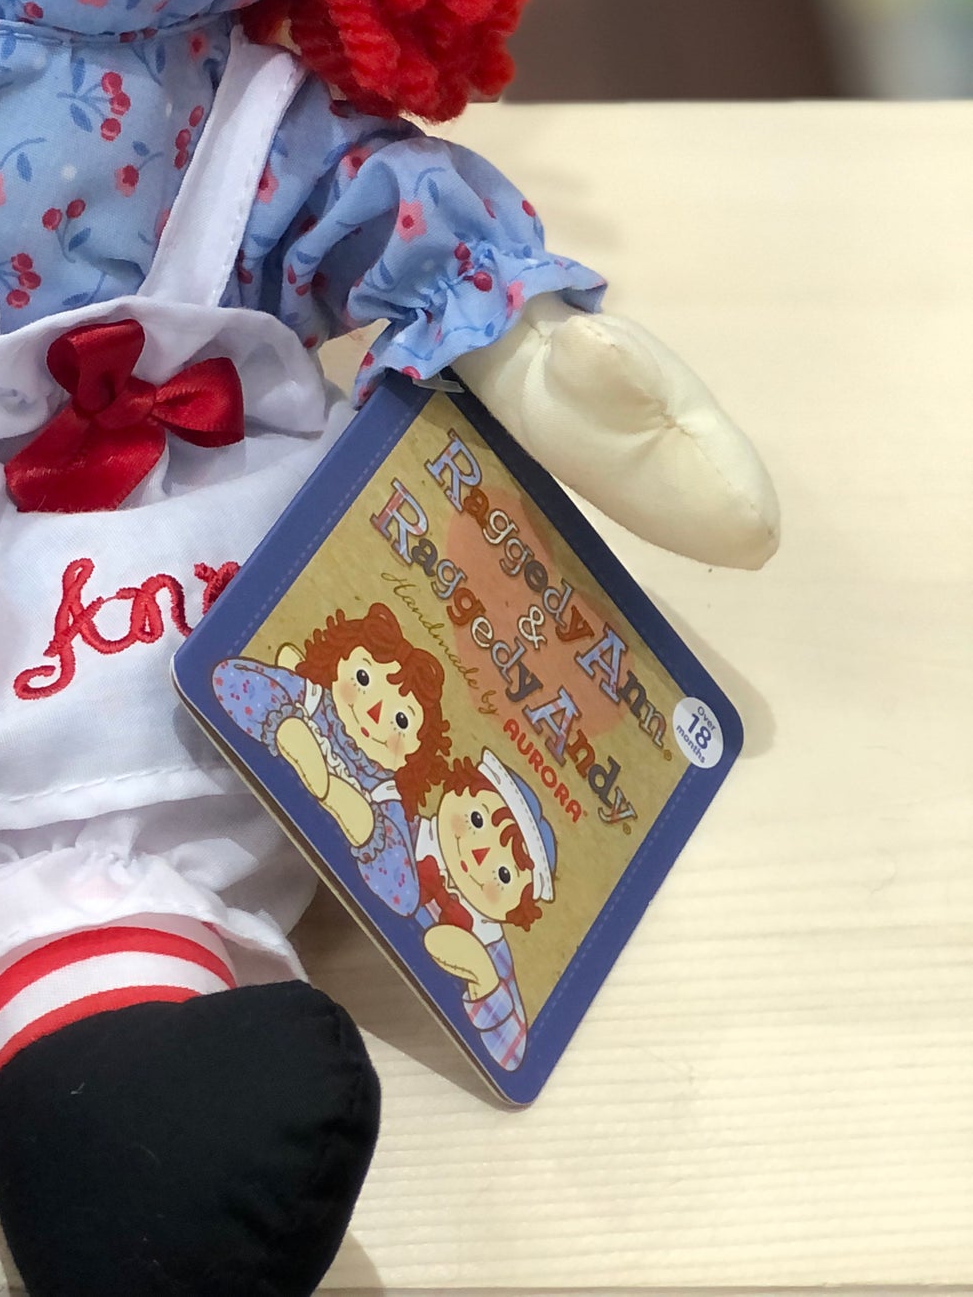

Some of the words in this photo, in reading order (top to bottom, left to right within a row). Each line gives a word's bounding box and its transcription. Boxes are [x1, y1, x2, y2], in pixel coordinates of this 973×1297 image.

[425, 429, 595, 644] Raggedy
[370, 477, 544, 704] Raggedy
[517, 605, 548, 650] &
[381, 571, 479, 690] Handmade
[478, 689, 500, 717] by
[503, 718, 583, 823] AURORA
[697, 705, 716, 731] Over
[675, 724, 706, 764] months
[687, 712, 712, 750] 18
